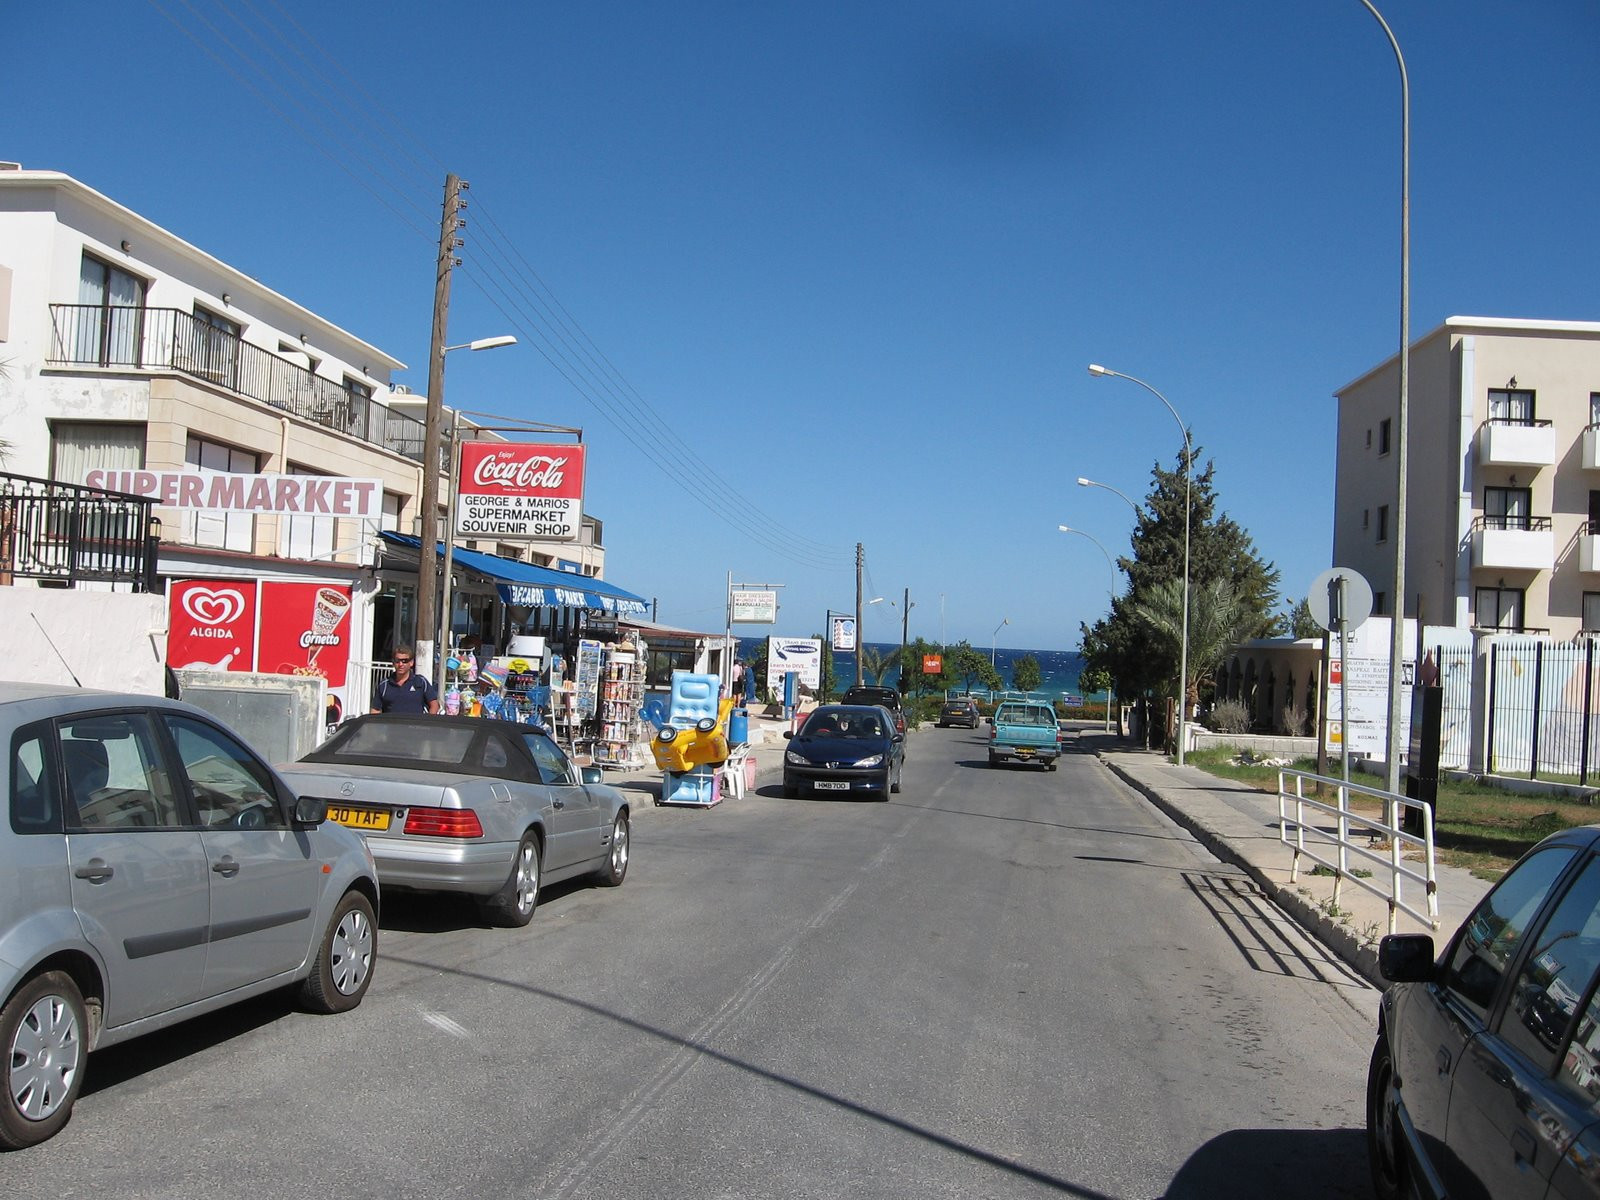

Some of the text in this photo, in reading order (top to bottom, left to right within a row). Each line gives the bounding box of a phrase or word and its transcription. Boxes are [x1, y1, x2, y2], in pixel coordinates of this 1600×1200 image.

[473, 453, 568, 489] Coca-Cola
[85, 469, 376, 515] SUPERMARKET
[464, 496, 570, 509] GEORGE & MARIOS
[468, 508, 566, 522] SUPERMARKET
[462, 520, 571, 536] SOUVENIR SHOP
[190, 626, 234, 639] ALGIDA
[300, 630, 340, 648] Cornetto
[329, 808, 382, 825] 30 TAF
